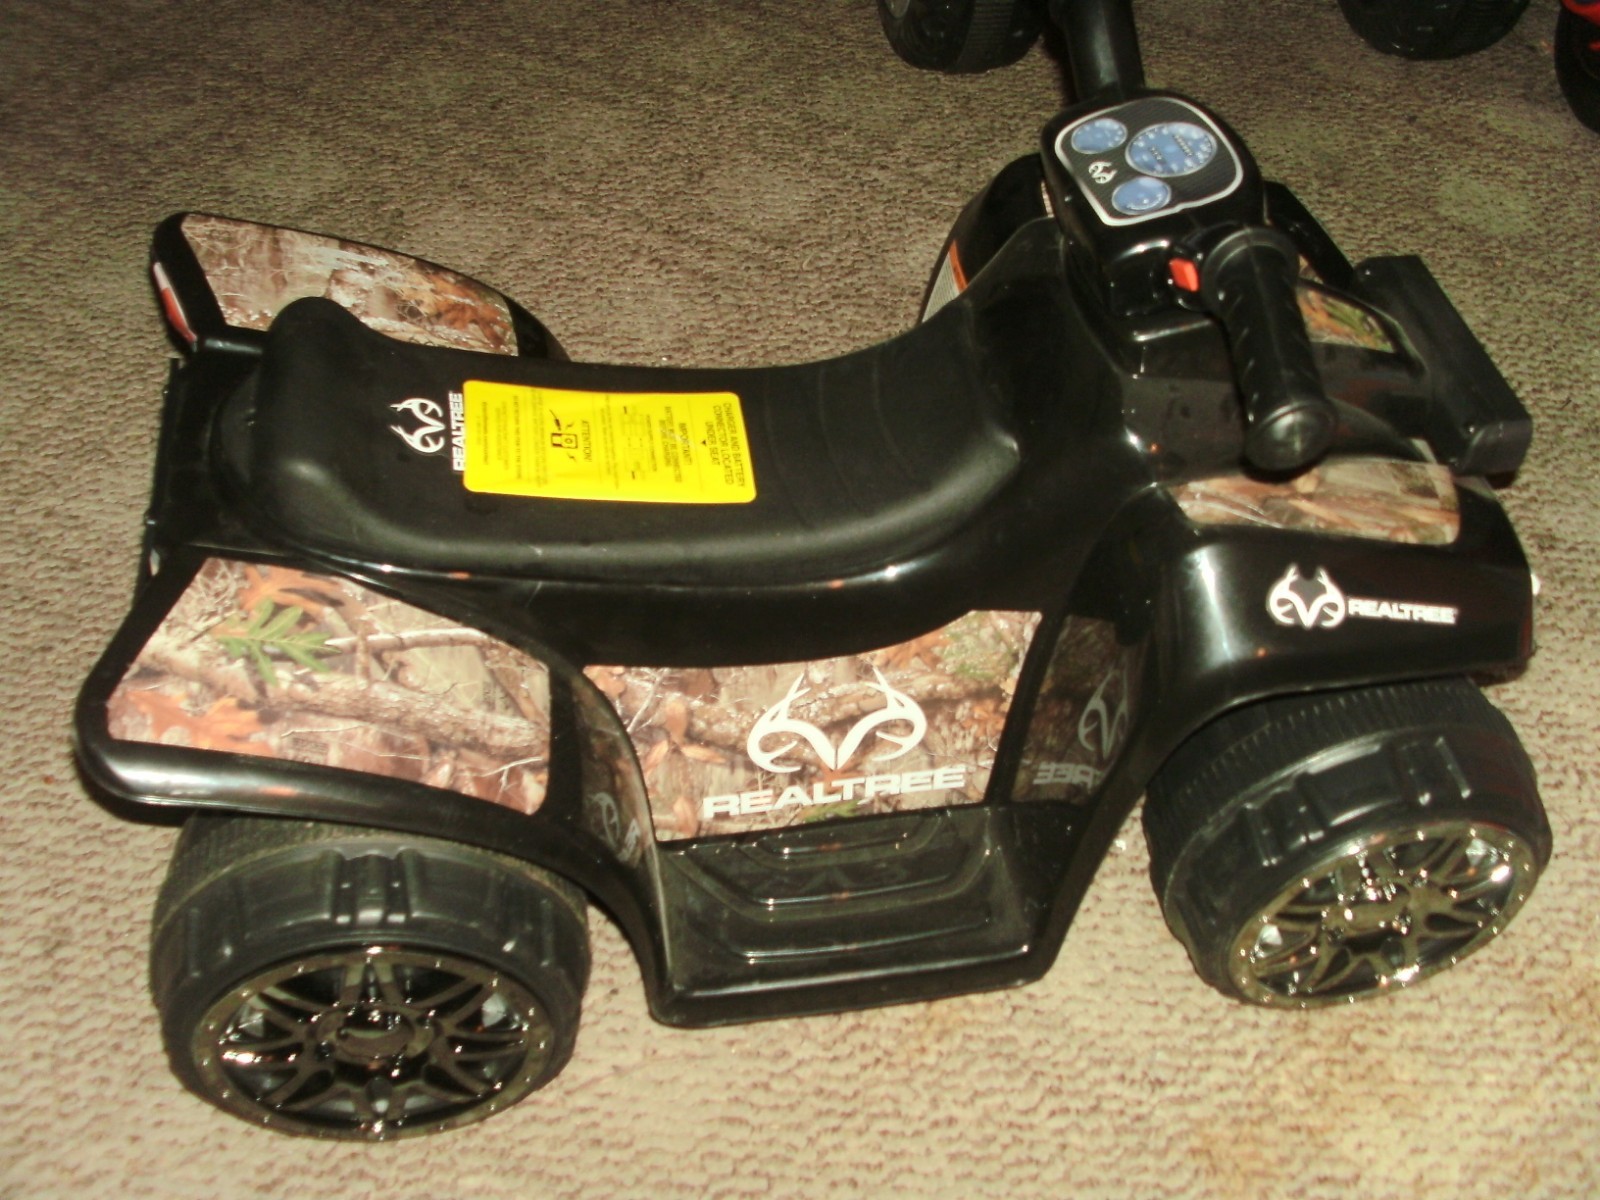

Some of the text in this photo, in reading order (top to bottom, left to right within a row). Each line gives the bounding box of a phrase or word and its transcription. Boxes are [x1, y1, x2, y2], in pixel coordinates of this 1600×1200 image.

[448, 391, 466, 471] REALTREE
[705, 421, 720, 466] UNDER SEAT
[713, 405, 734, 485] CONNECTOR LOCATED
[723, 402, 745, 487] CHARGER AND BATTERY
[1348, 598, 1457, 624] REALTREE
[703, 766, 966, 820] REALTREE
